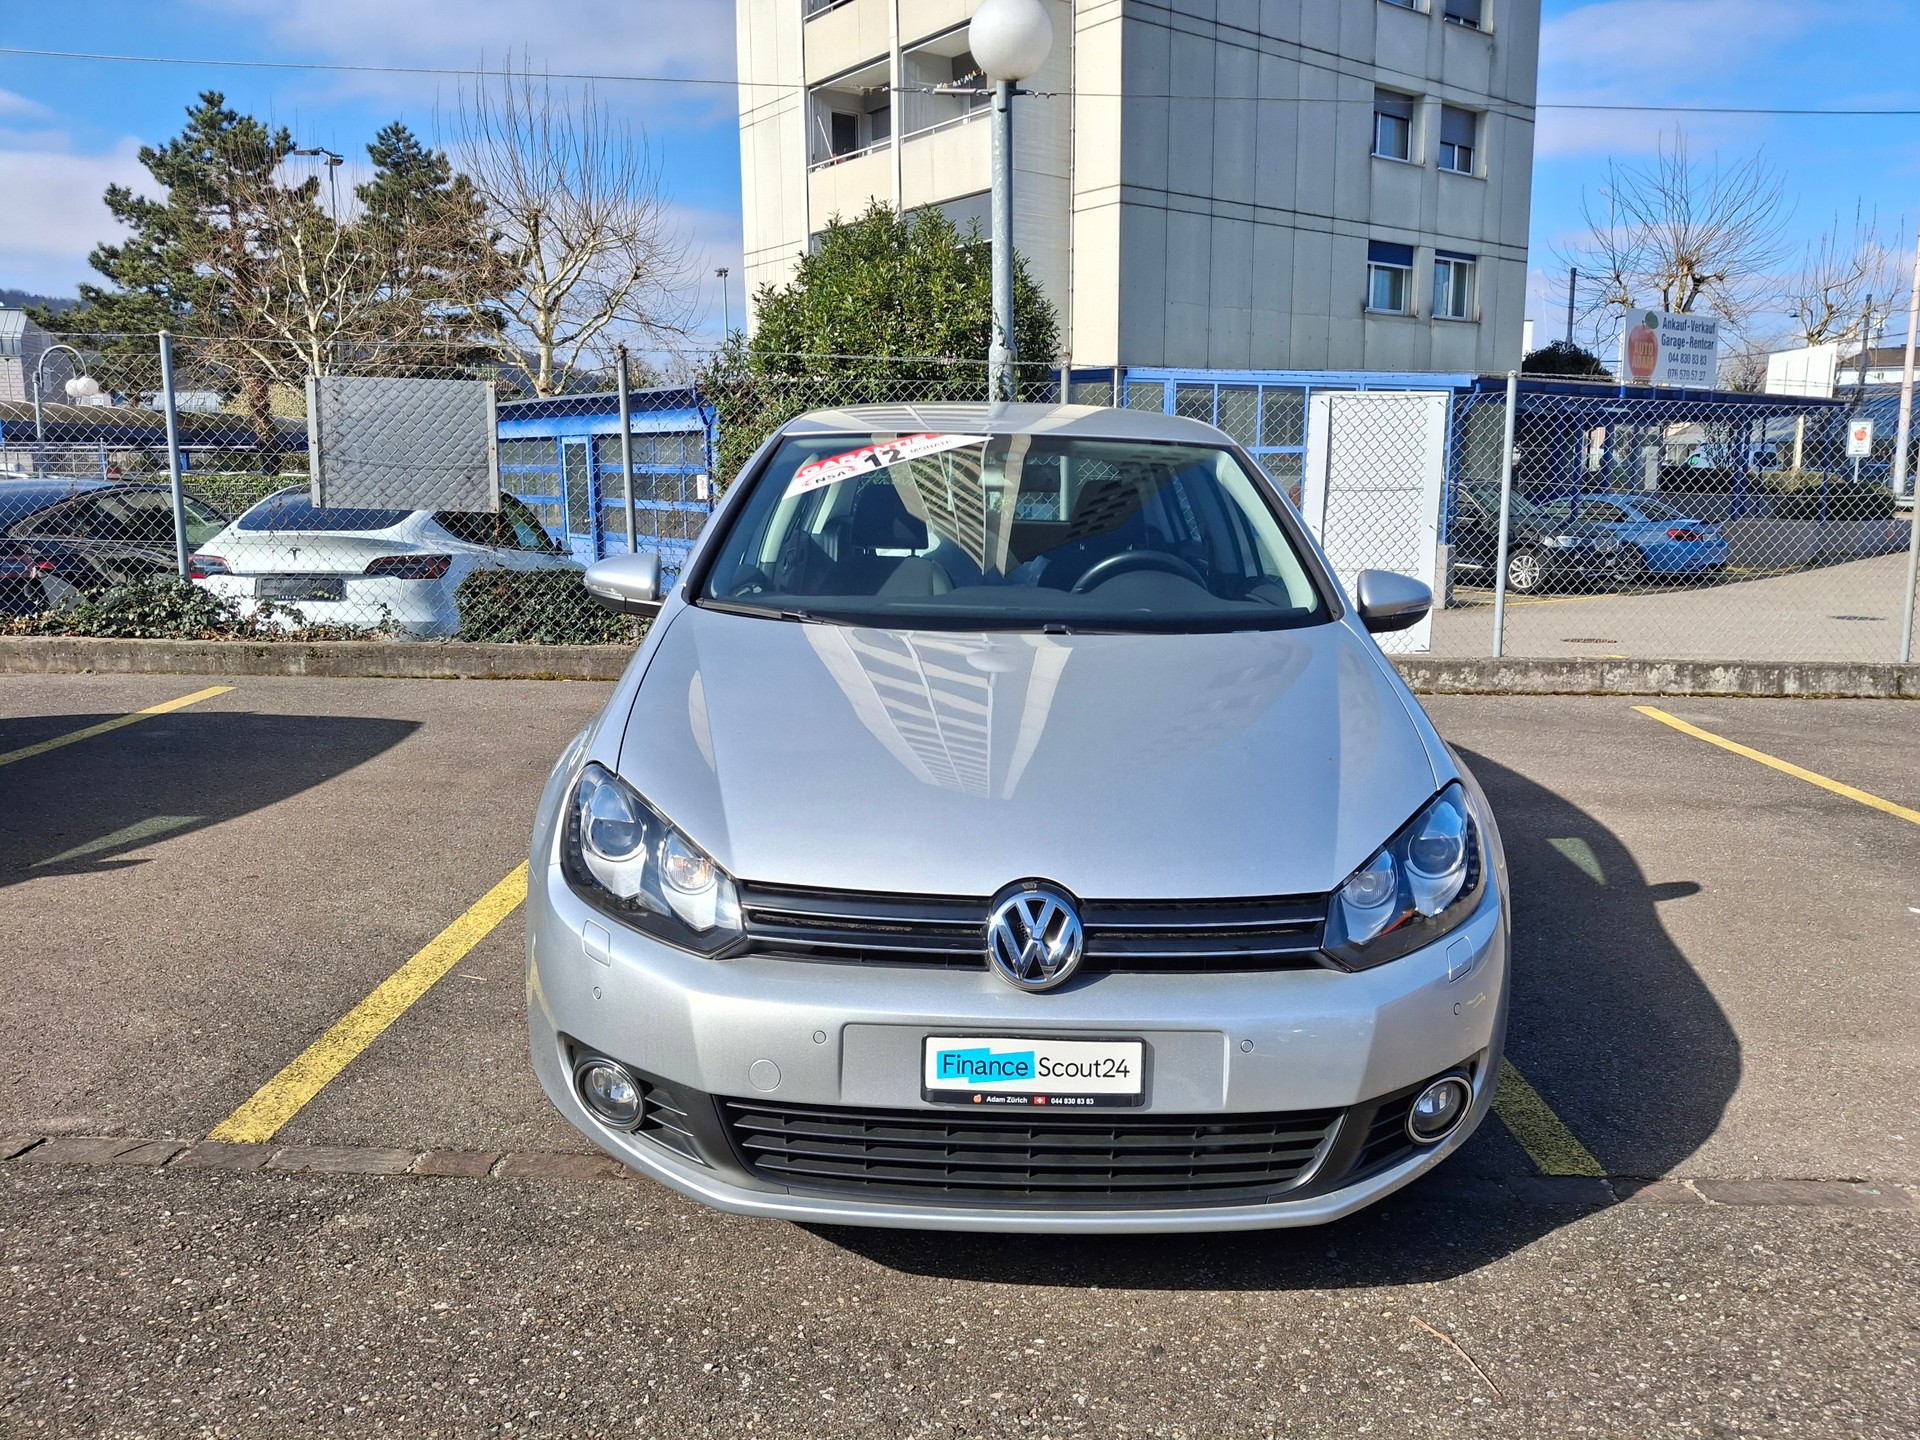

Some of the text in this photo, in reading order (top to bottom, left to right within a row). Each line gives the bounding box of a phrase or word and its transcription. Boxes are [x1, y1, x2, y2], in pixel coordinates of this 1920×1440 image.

[1633, 341, 1654, 355] AUTO
[1668, 352, 1707, 366] 044 830 83 83
[801, 434, 927, 476] GARANTIE
[815, 440, 951, 483] NSA 12 MONATE
[989, 893, 1081, 989] VW
[943, 1054, 1130, 1078] Finance Scout24
[1006, 1096, 1028, 1104] Zürich
